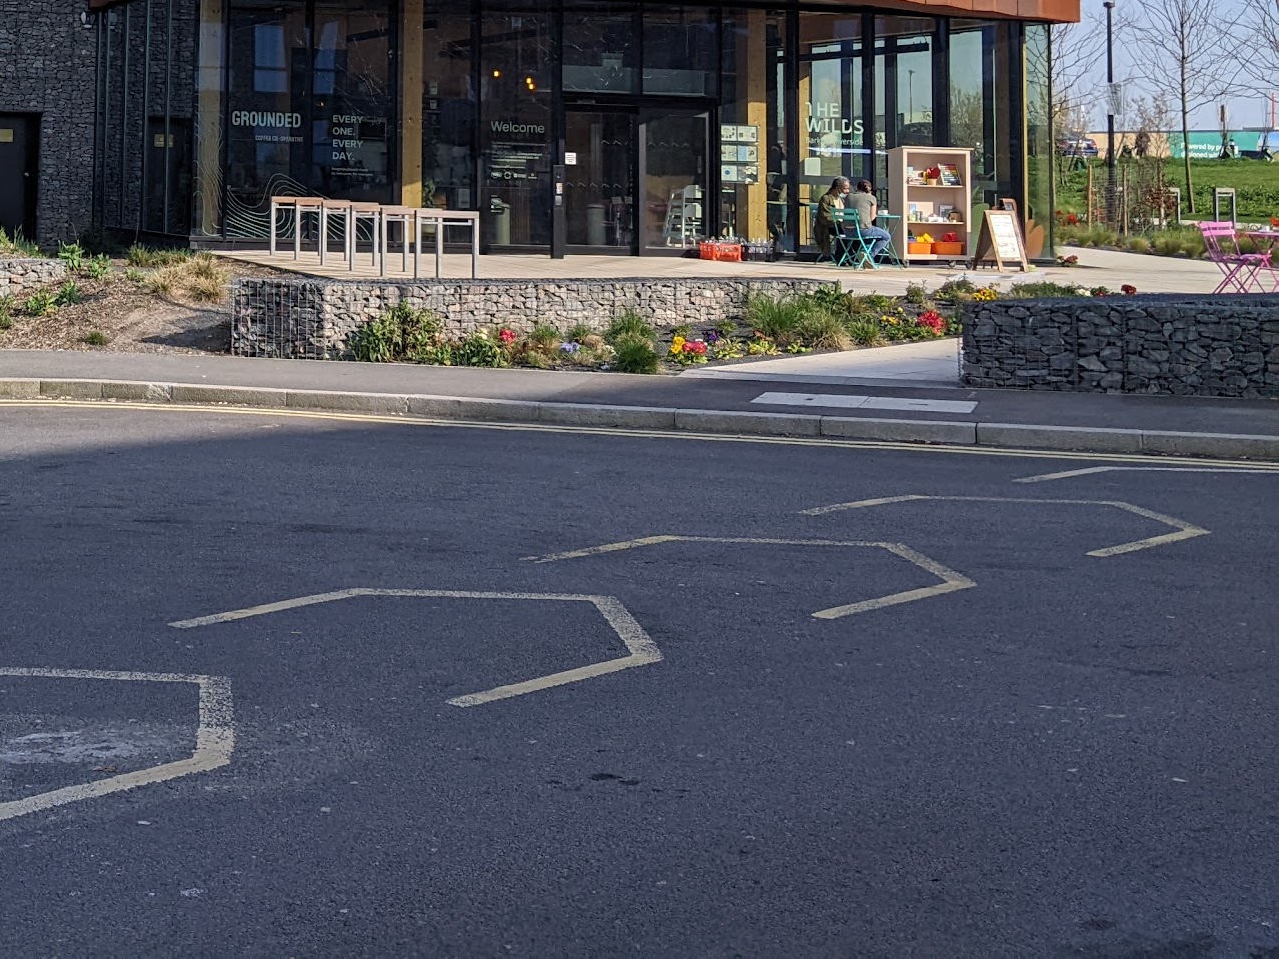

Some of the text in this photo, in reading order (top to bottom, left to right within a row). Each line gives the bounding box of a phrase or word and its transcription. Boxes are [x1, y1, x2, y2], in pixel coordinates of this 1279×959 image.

[804, 102, 840, 118] THE
[231, 110, 302, 128] GROUNDED
[332, 114, 364, 124] EVERY
[332, 126, 356, 137] ONE.
[490, 120, 546, 134] Welcome
[804, 117, 865, 135] WILDS
[332, 138, 364, 149] EVERY
[834, 137, 864, 145] iverside
[1181, 142, 1207, 150] Pwered
[1207, 143, 1215, 151] by
[332, 151, 355, 161] DAY.
